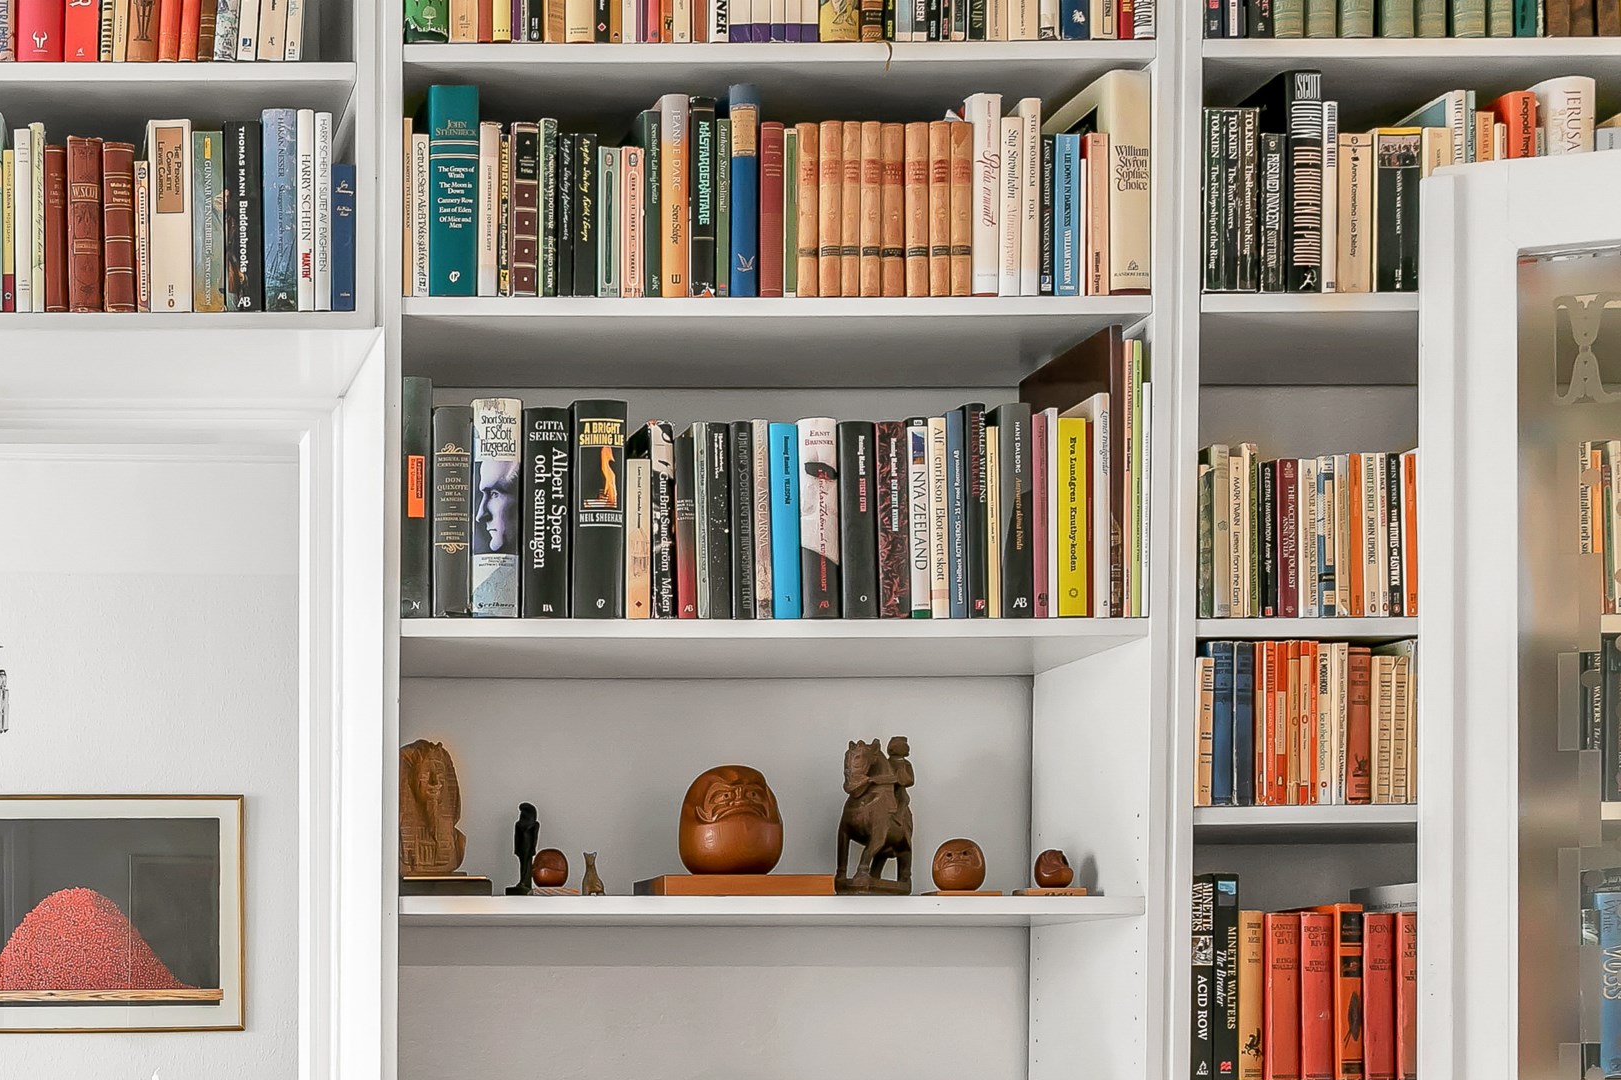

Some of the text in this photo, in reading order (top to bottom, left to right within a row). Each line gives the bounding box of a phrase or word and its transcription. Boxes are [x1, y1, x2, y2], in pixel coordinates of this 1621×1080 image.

[435, 129, 477, 137] STEINBECK
[1114, 146, 1149, 157] William
[1118, 156, 1147, 169] Styron
[699, 121, 710, 226] MÄSTARBERÄTTARE
[1115, 167, 1149, 181] Sophie's
[1115, 179, 1148, 193] Choice
[302, 154, 311, 241] HARRY SCHEIN
[239, 201, 248, 273] Buddenbrooks
[481, 415, 517, 426] Short Stories
[535, 420, 564, 430] GITTA
[584, 422, 620, 434] A BRIGHT
[529, 431, 568, 442] SERENY
[579, 434, 624, 446] SHINING LIE
[805, 438, 834, 447] BRUNNER
[480, 440, 516, 457] Fitzgerald
[437, 484, 468, 492] QUIXOTE
[546, 447, 568, 552] Albert Speer
[1069, 437, 1077, 572] Eva Lundgren Knutby-koden
[530, 454, 545, 569] och sanningen
[580, 513, 623, 524] NEIL SHEEHAN
[913, 471, 928, 571] NYA ZEELAND
[659, 472, 671, 613] Gun-Britt Sundström Maken
[1013, 597, 1028, 608] AB
[1192, 882, 1203, 932] WALTERS
[1203, 882, 1213, 932] MINETTE
[1227, 926, 1236, 1030] MINETTE WALTERS
[1197, 975, 1208, 1041] ACID ROW
